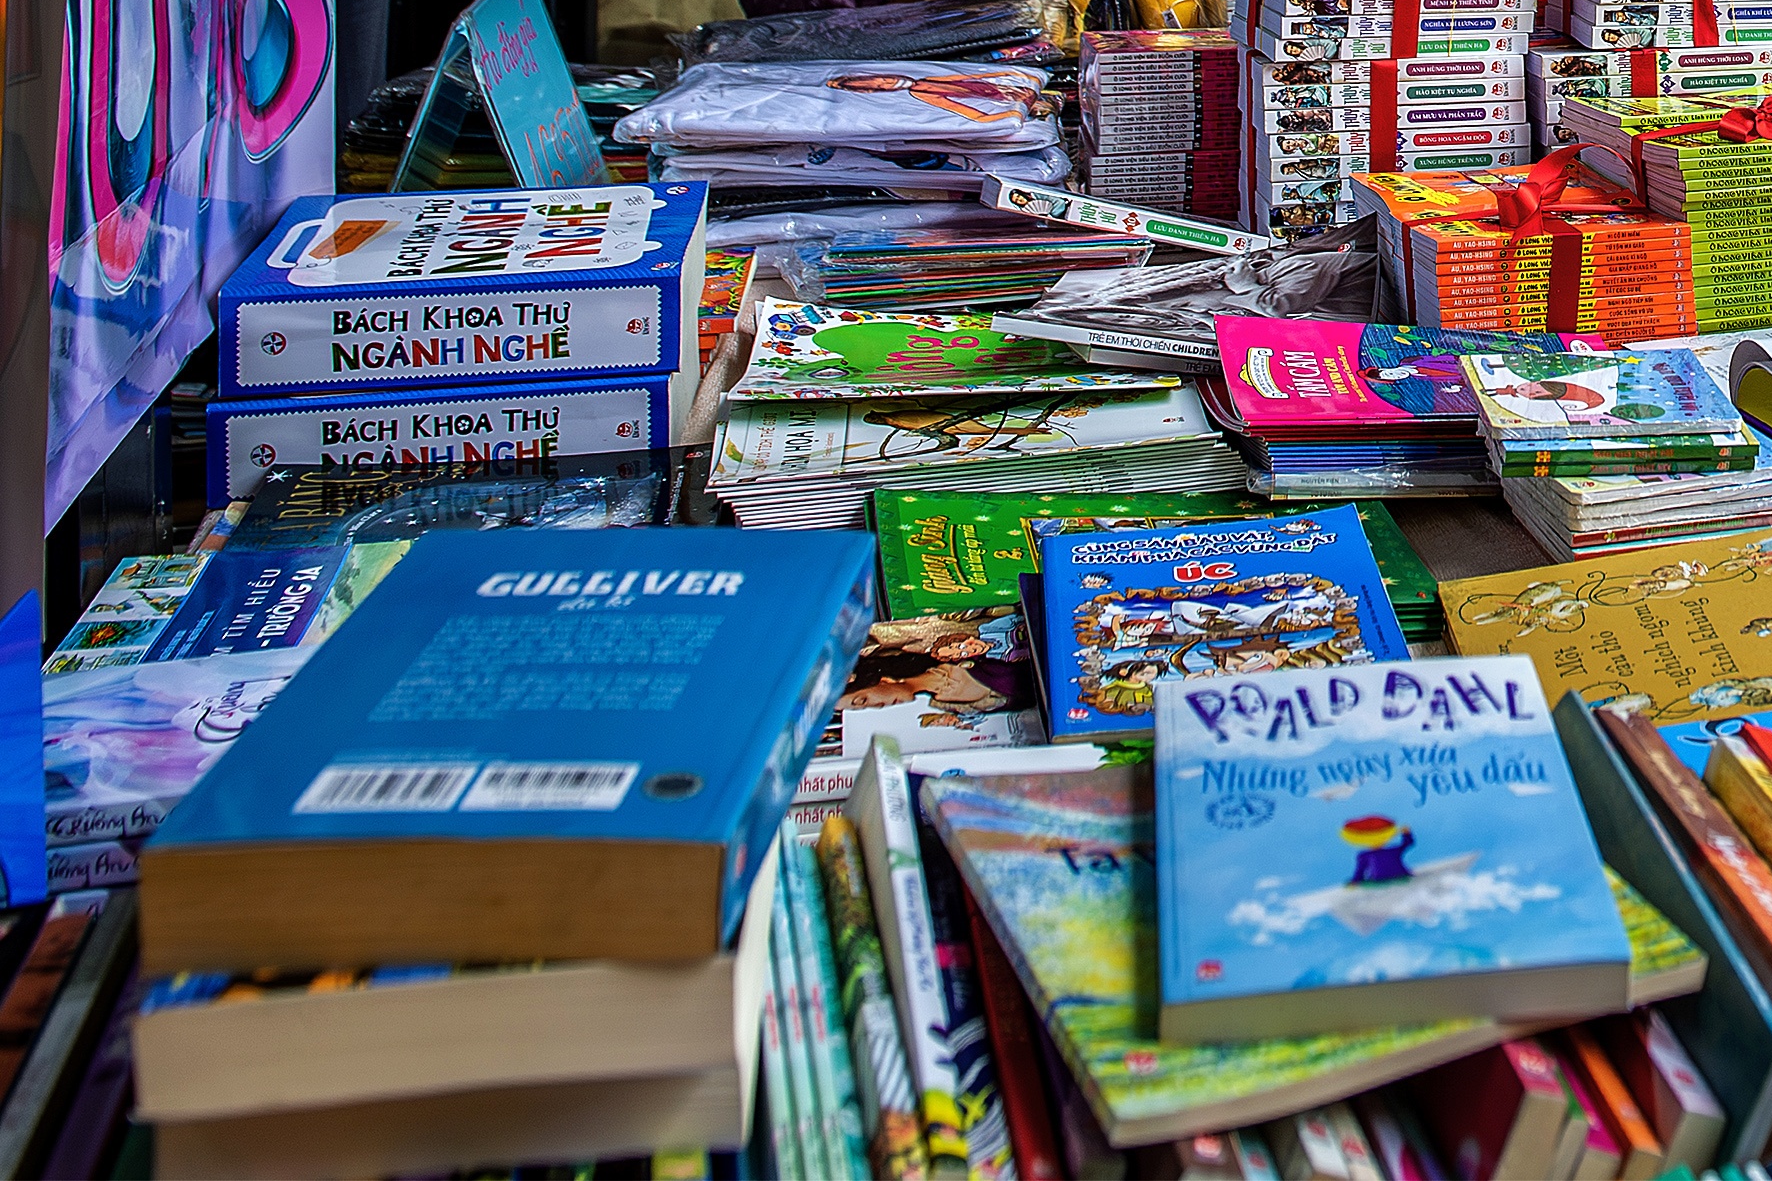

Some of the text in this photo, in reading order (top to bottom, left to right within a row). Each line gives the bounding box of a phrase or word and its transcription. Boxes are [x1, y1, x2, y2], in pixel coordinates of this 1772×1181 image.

[387, 198, 455, 278] BÁCH KHOA THƯ
[429, 197, 532, 276] NGÀNH
[523, 200, 612, 260] NGHỀ
[332, 300, 572, 335] BÁCH KHOA THƯ
[330, 325, 572, 373] NGÀNH NGHỀ
[1088, 331, 1106, 344] TRẺ
[1106, 334, 1121, 346] EM
[1172, 343, 1221, 358] CHILDREN
[1279, 350, 1332, 398] TẤM CÁM
[321, 406, 562, 446] BÁCH KHOA THƯ
[784, 430, 820, 453] HỌA
[788, 410, 817, 427] MI
[906, 515, 975, 594] Giáng Sinh
[1071, 538, 1132, 555] CÙNG
[475, 570, 746, 598] GULLIVER
[1173, 561, 1238, 583] ÚC
[222, 568, 282, 641] TÌM HIỂU
[1553, 644, 1588, 679] Một
[1184, 669, 1537, 744] ROALD DAHL
[1201, 759, 1310, 798] Những
[1316, 745, 1395, 793] ngày
[1406, 744, 1549, 808] yêu dấu
